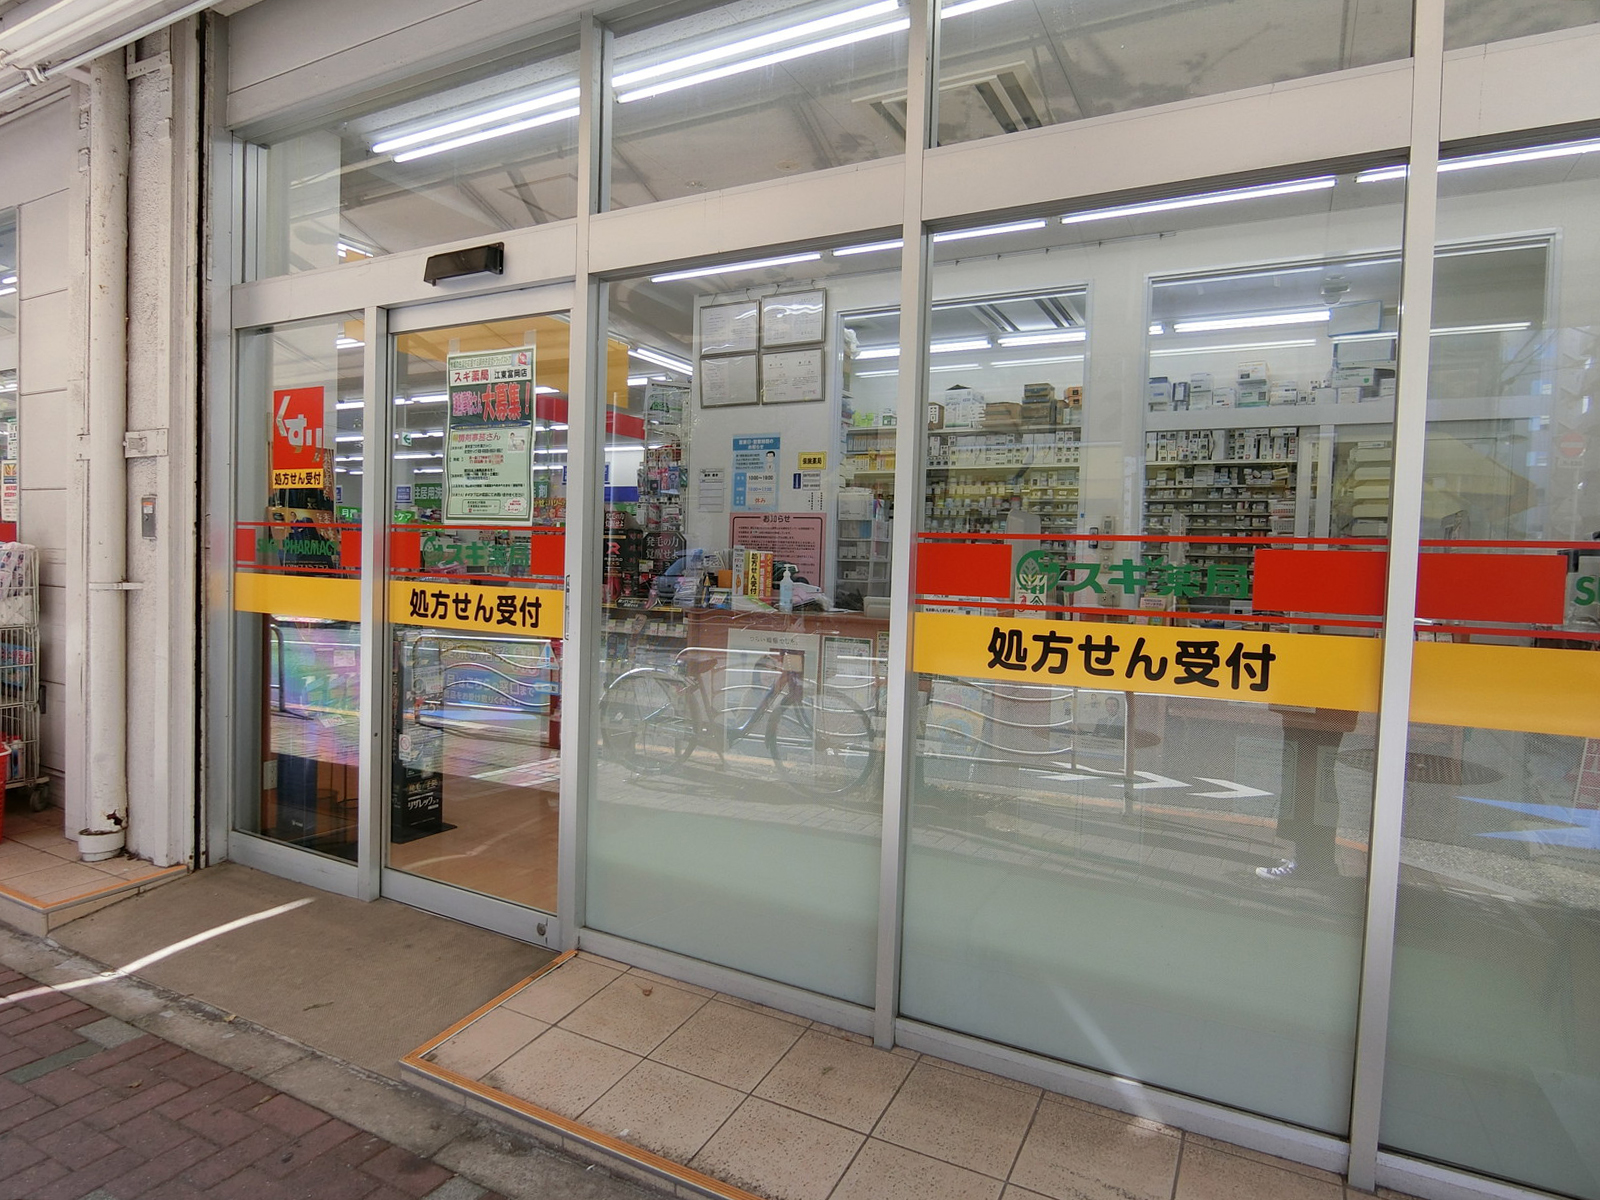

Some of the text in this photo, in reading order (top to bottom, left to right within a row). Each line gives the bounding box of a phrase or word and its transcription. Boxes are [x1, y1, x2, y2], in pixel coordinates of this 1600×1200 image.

[454, 368, 527, 383] スギ薬局 江東富岡店
[276, 396, 322, 462] くすり
[274, 472, 321, 485] 処方せん受付
[446, 540, 531, 567] スギ薬局
[646, 536, 680, 547] 発毛の力
[1063, 556, 1250, 599] スギ薬局
[1573, 576, 1600, 606] S
[409, 588, 542, 628] 処方せん受付
[987, 626, 1276, 692] 処方せん受付
